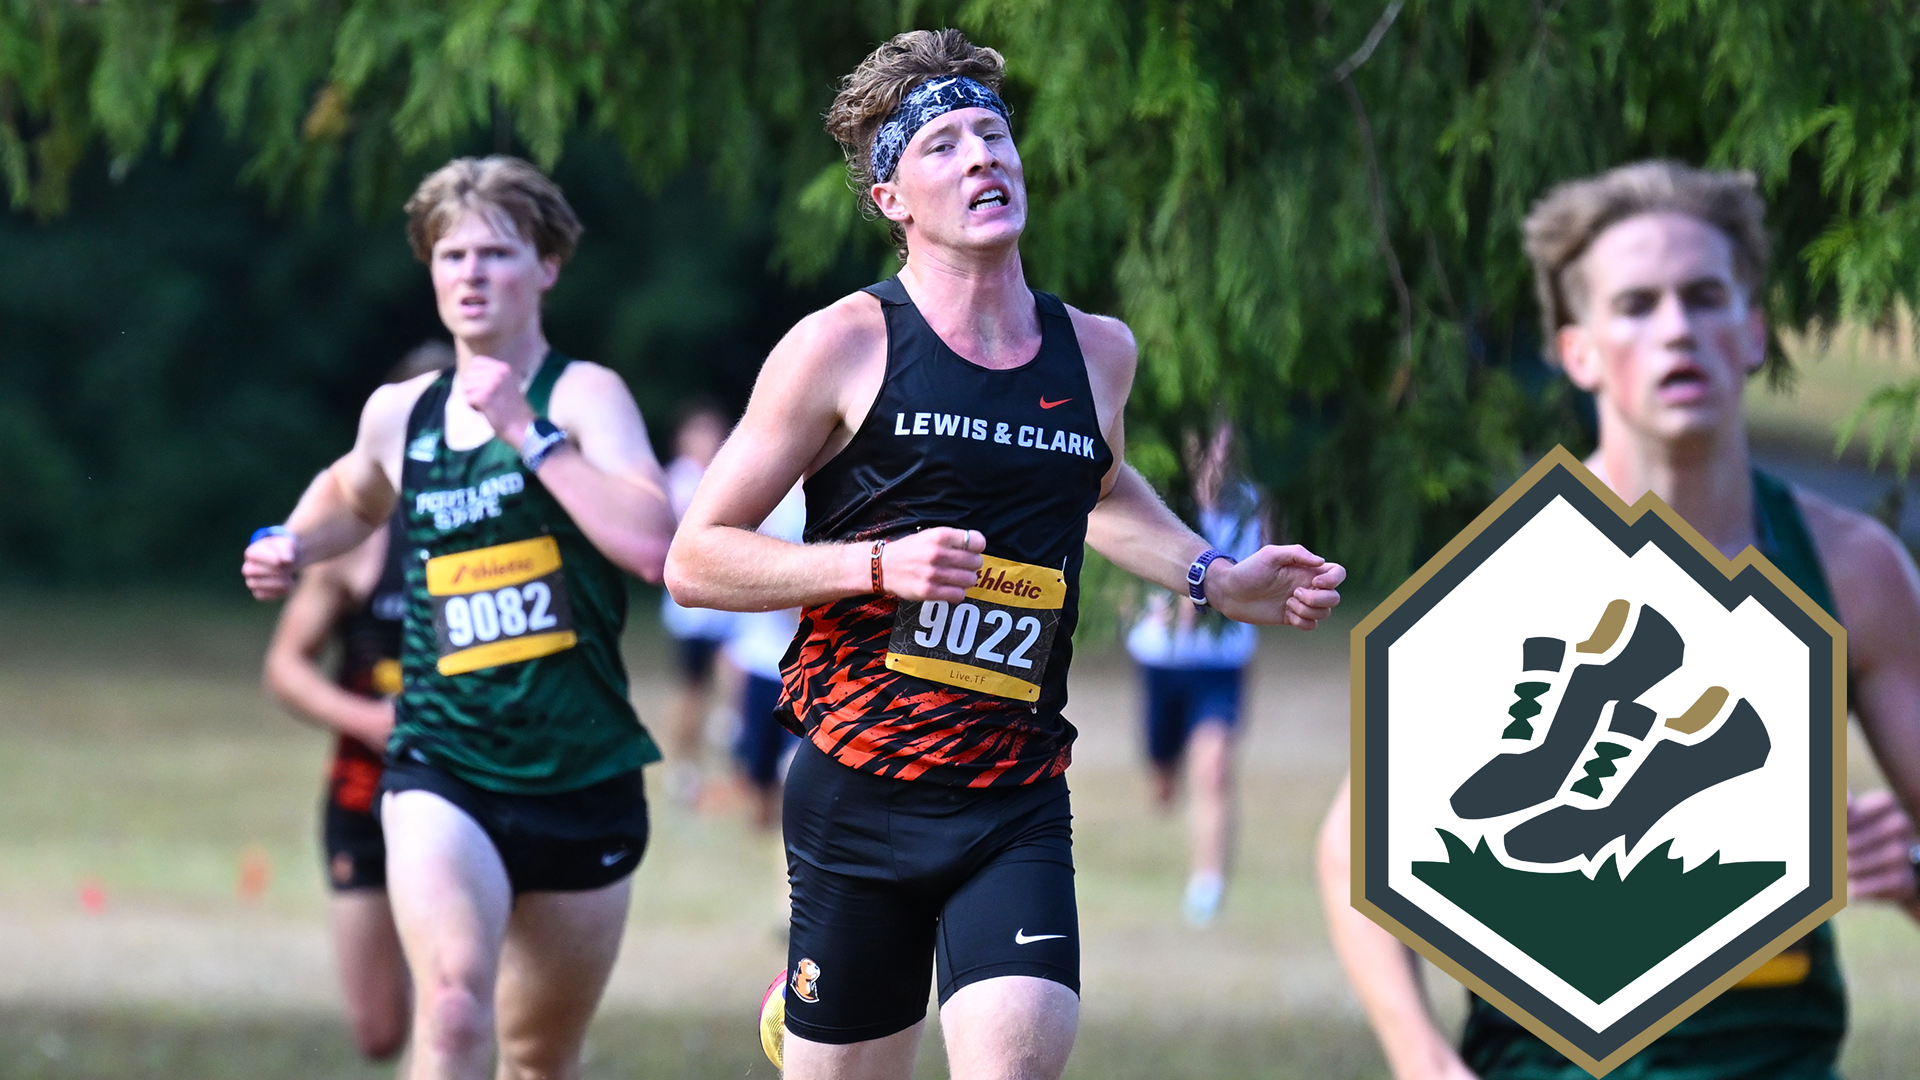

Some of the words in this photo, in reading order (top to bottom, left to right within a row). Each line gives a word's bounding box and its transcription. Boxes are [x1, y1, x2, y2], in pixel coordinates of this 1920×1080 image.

[894, 412, 988, 441] LEWIS
[993, 421, 1013, 445] &
[1017, 425, 1096, 460] CLARK
[974, 567, 1042, 600] thletic
[445, 581, 557, 647] 9082
[914, 600, 1042, 669] 9022
[949, 669, 987, 685] Live.TF
